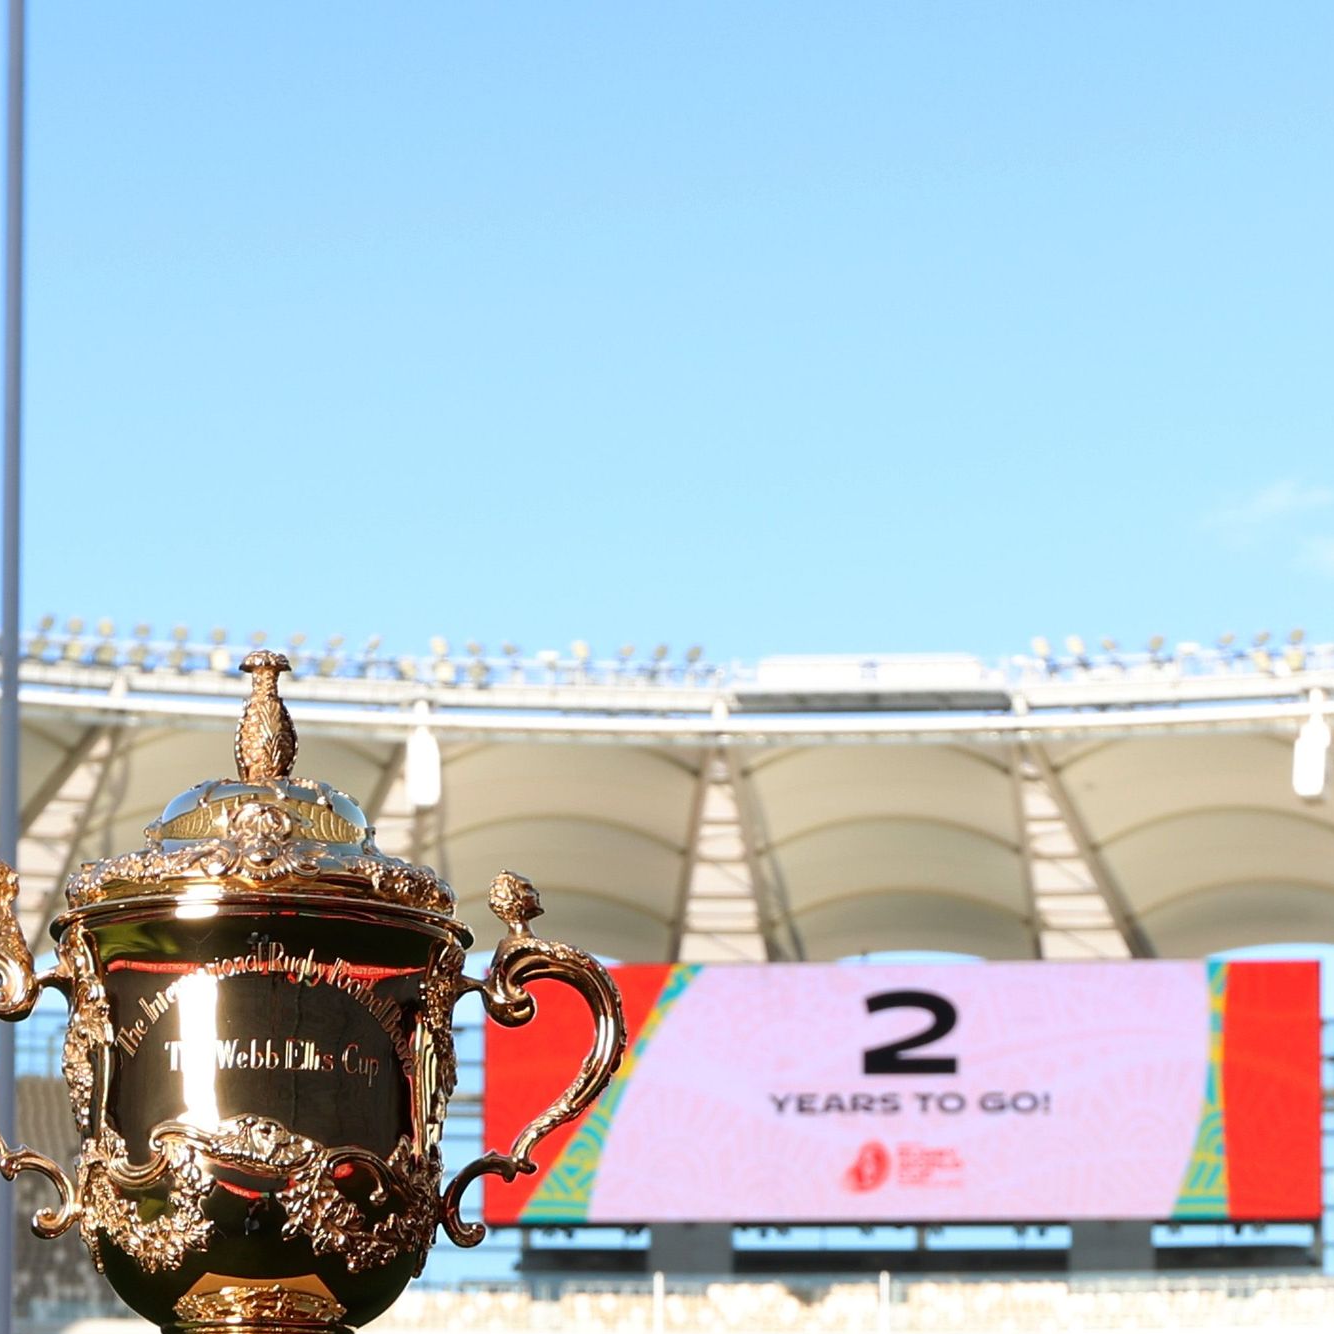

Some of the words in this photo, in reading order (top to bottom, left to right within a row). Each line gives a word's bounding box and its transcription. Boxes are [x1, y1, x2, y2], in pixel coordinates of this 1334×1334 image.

[115, 1018, 149, 1057] The
[139, 942, 267, 1024] Intetional
[268, 942, 325, 987] Rugby
[326, 957, 394, 1022] Football
[863, 989, 958, 1075] 2
[214, 1039, 279, 1070] Webb
[284, 1038, 333, 1071] Ellis
[341, 1043, 379, 1088] Cup
[770, 1092, 900, 1114] YEARS
[914, 1092, 965, 1114] TO
[978, 1092, 1052, 1114] GO!
